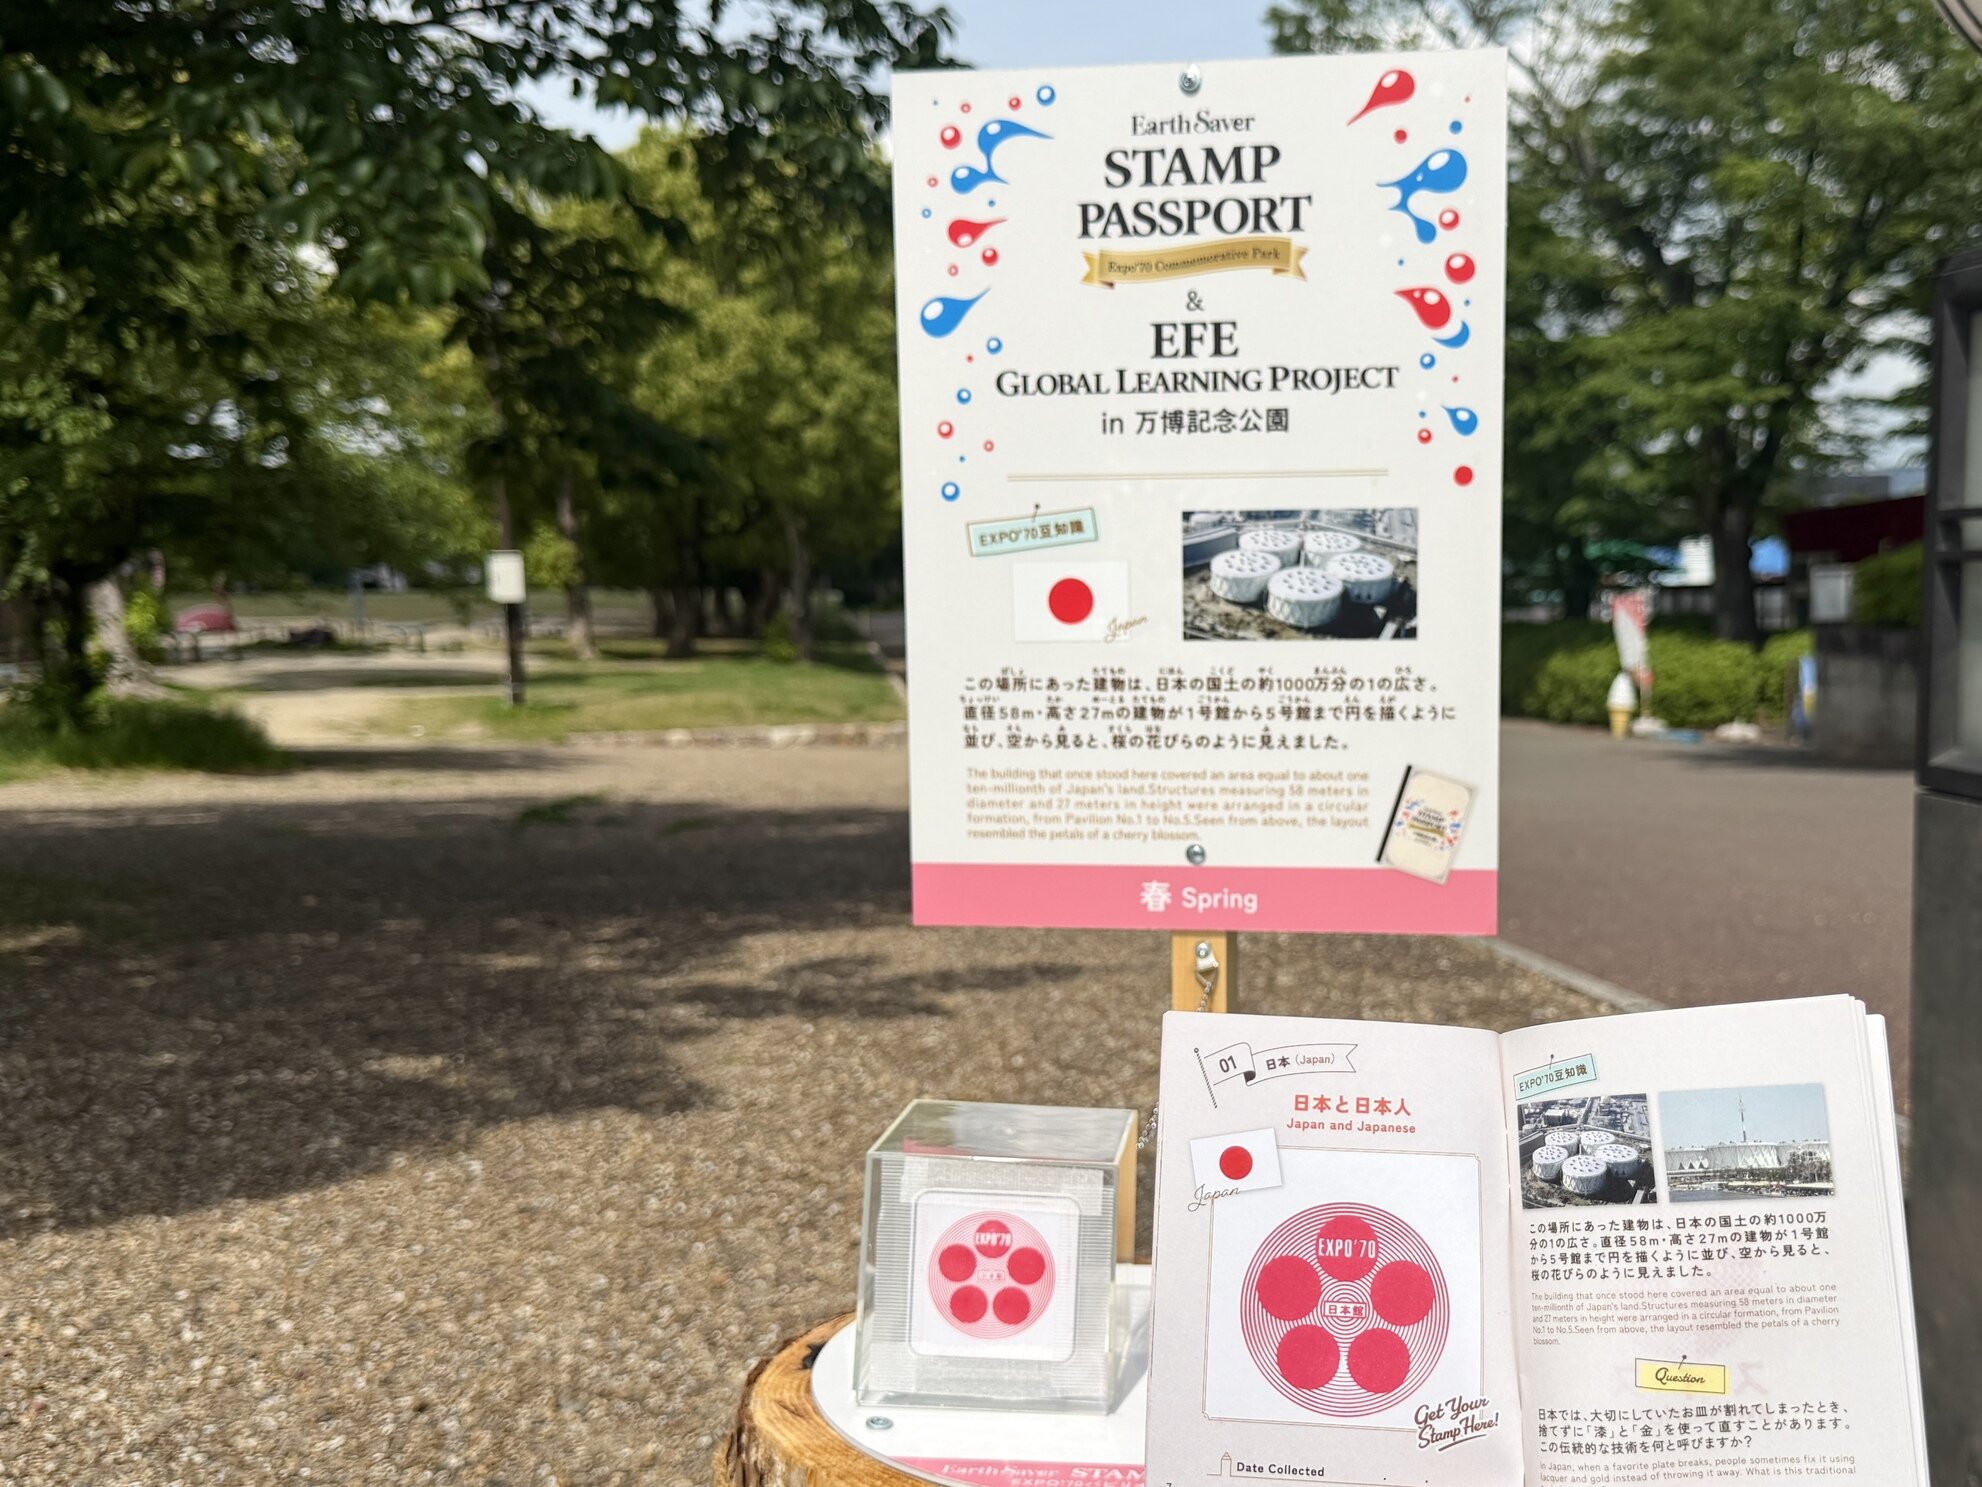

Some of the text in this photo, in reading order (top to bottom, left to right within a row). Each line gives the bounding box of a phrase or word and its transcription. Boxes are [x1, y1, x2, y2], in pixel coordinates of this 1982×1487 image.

[1132, 111, 1254, 135] Earth Saver
[1105, 145, 1280, 188] STAMP
[1079, 195, 1311, 238] PASSPORT
[1186, 291, 1203, 311] &
[1152, 322, 1238, 358] EFE
[996, 366, 1398, 396] GLOBAL LEARNING PROJECT
[1103, 408, 1288, 434] in 万博記念公園
[967, 767, 1368, 782] The building that once stood here covered an area equal to about one
[1141, 881, 1257, 914] 春 Spring
[1219, 1056, 1236, 1073] 01
[1266, 1056, 1290, 1070] 日本
[1294, 1095, 1411, 1116] 日本と日本人
[1287, 1118, 1415, 1134] Japan and Japanese
[1187, 1184, 1241, 1213] Japan
[1530, 1211, 1826, 1234] この場所にあった建物は、日本の国土の約1000万
[1531, 1265, 1711, 1281] 桜の花びらのように見えました。
[1531, 1292, 1542, 1300] The
[1544, 1292, 1573, 1301] building
[1619, 1290, 1644, 1299] stood
[1647, 1290, 1667, 1298] here
[1670, 1289, 1707, 1297] covered
[1748, 1285, 1773, 1295] equal
[1789, 1284, 1816, 1292] about
[1532, 1303, 1573, 1311] ten-millionth
[1576, 1302, 1583, 1311] of
[1586, 1302, 1618, 1312] Japan's
[1620, 1301, 1688, 1310] land.Structures
[1691, 1299, 1736, 1308] measuring
[1739, 1297, 1749, 1306] 58
[1752, 1297, 1783, 1305] meters
[1797, 1295, 1836, 1303] diameter
[1544, 1314, 1551, 1322] 27
[1589, 1314, 1614, 1324] height
[1640, 1312, 1678, 1322] arranged
[1699, 1310, 1731, 1319] circular
[1733, 1308, 1778, 1318] formation,
[1781, 1307, 1802, 1315] from
[1805, 1306, 1838, 1314] Pavilion
[1533, 1325, 1545, 1333] No.1
[1556, 1325, 1594, 1333] No.5.Seen
[1597, 1325, 1616, 1333] from
[1619, 1325, 1647, 1333] above,
[1650, 1324, 1664, 1332] the
[1667, 1324, 1693, 1333] layout
[1696, 1320, 1741, 1330] resembled
[1744, 1320, 1758, 1328] the
[1761, 1319, 1789, 1329] petals
[1791, 1317, 1800, 1326] of
[1811, 1317, 1839, 1327] cherry
[1533, 1337, 1560, 1345] blossom.
[1655, 1366, 1705, 1385] Question
[1414, 1395, 1489, 1425] Get Your
[1538, 1402, 1848, 1421] 日本では、大切にしていたお皿が割れてしまったとき、
[1418, 1412, 1499, 1449] Stamp Here!
[1237, 1462, 1324, 1476] Date Collected
[1550, 1462, 1575, 1471] Japan,
[1577, 1463, 1600, 1471] when
[1612, 1462, 1648, 1471] favorite
[1652, 1460, 1675, 1470] plate
[1678, 1458, 1711, 1467] breaks,
[1715, 1456, 1746, 1467] people
[1750, 1456, 1800, 1464] sometimes
[1804, 1454, 1815, 1462] fix
[1830, 1456, 1854, 1464] using
[1540, 1472, 1567, 1483] lacquer
[1571, 1474, 1586, 1482] and
[1590, 1474, 1609, 1484] gold
[1613, 1472, 1647, 1482] instead
[1650, 1471, 1660, 1480] of
[1663, 1471, 1703, 1479] throwing
[1717, 1469, 1742, 1477] away.
[1745, 1467, 1769, 1475] What
[1784, 1466, 1802, 1474] this
[1806, 1466, 1855, 1474] traditional
